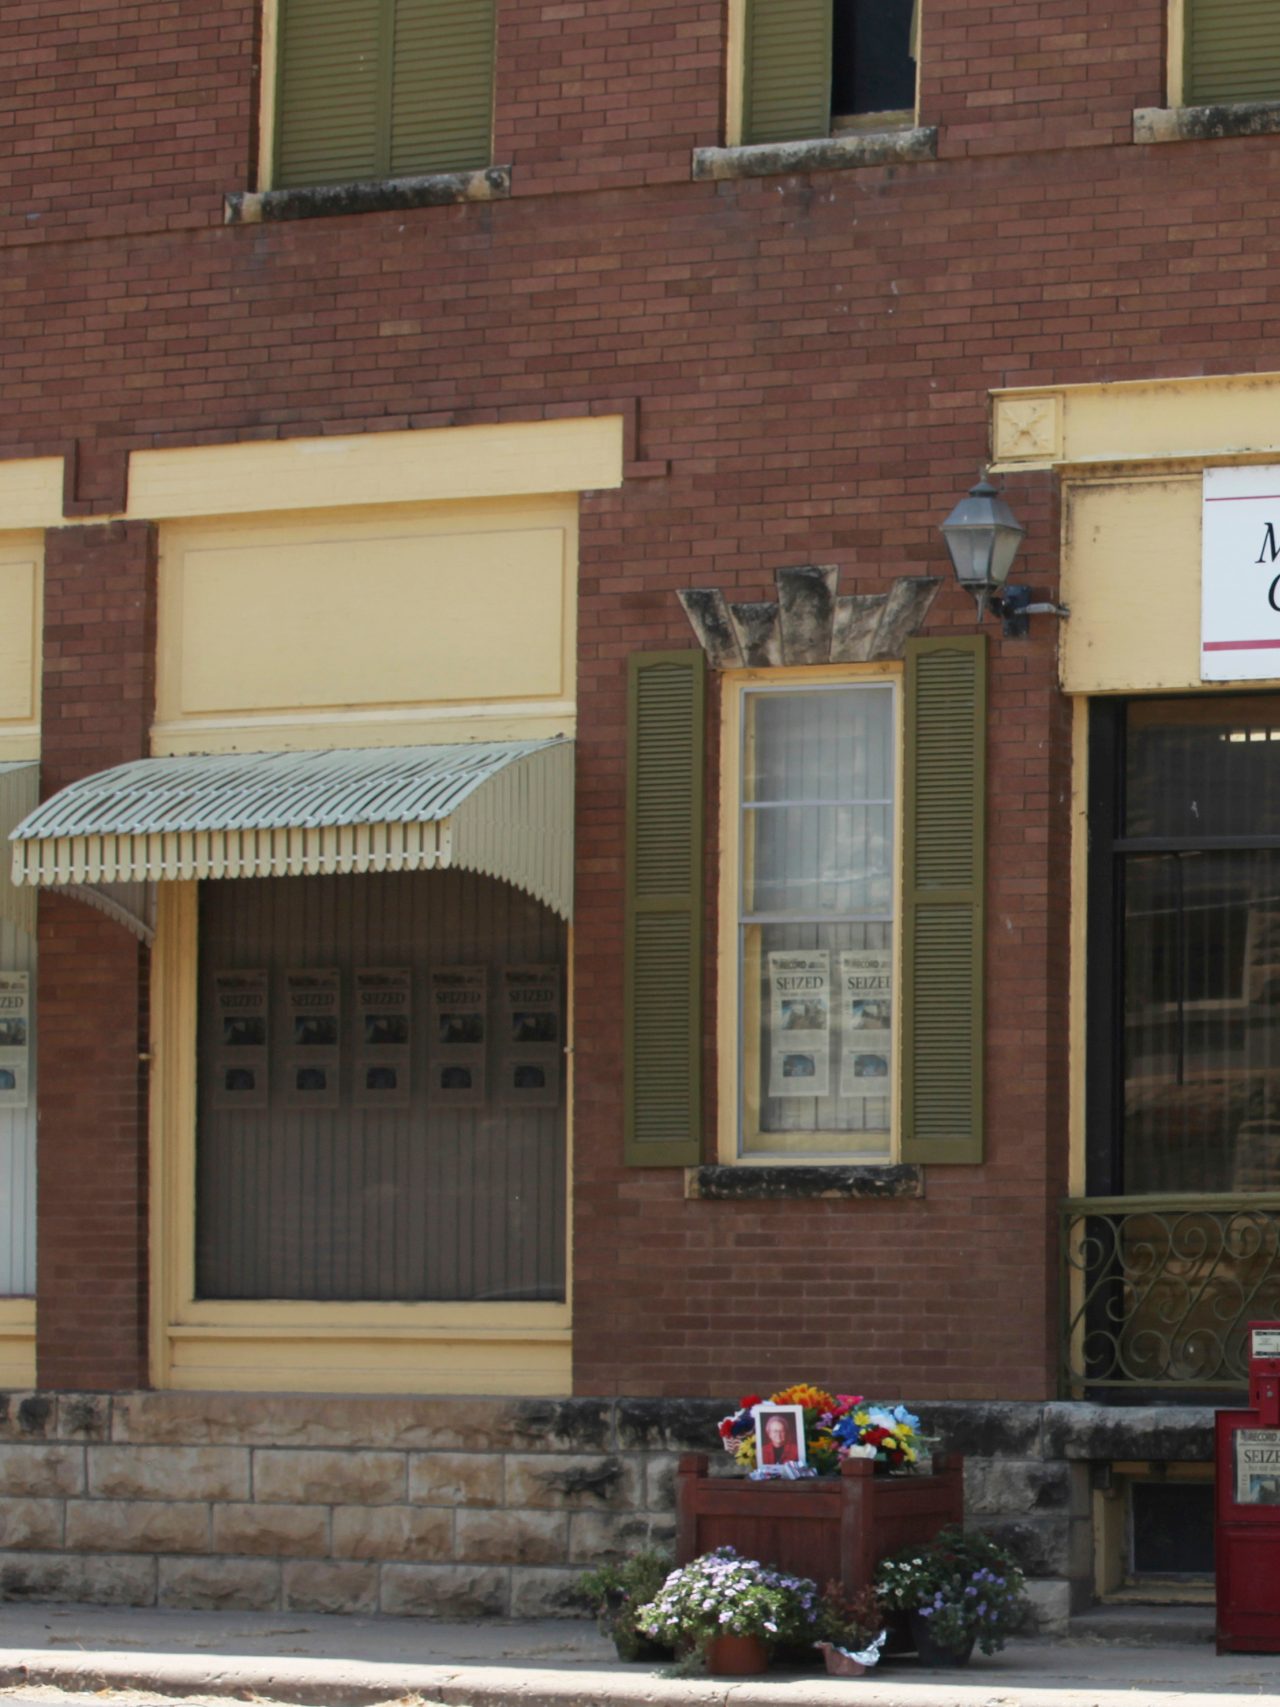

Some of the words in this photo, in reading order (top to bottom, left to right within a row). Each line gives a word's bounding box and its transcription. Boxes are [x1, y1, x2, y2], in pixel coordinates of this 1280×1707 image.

[776, 976, 824, 991] SEIZED
[219, 993, 263, 1008] SEIZED
[290, 993, 334, 1007] SEIZED
[360, 991, 405, 1006] SEIZED
[435, 990, 481, 1005] SEIZED
[508, 989, 554, 1004] SEIZED
